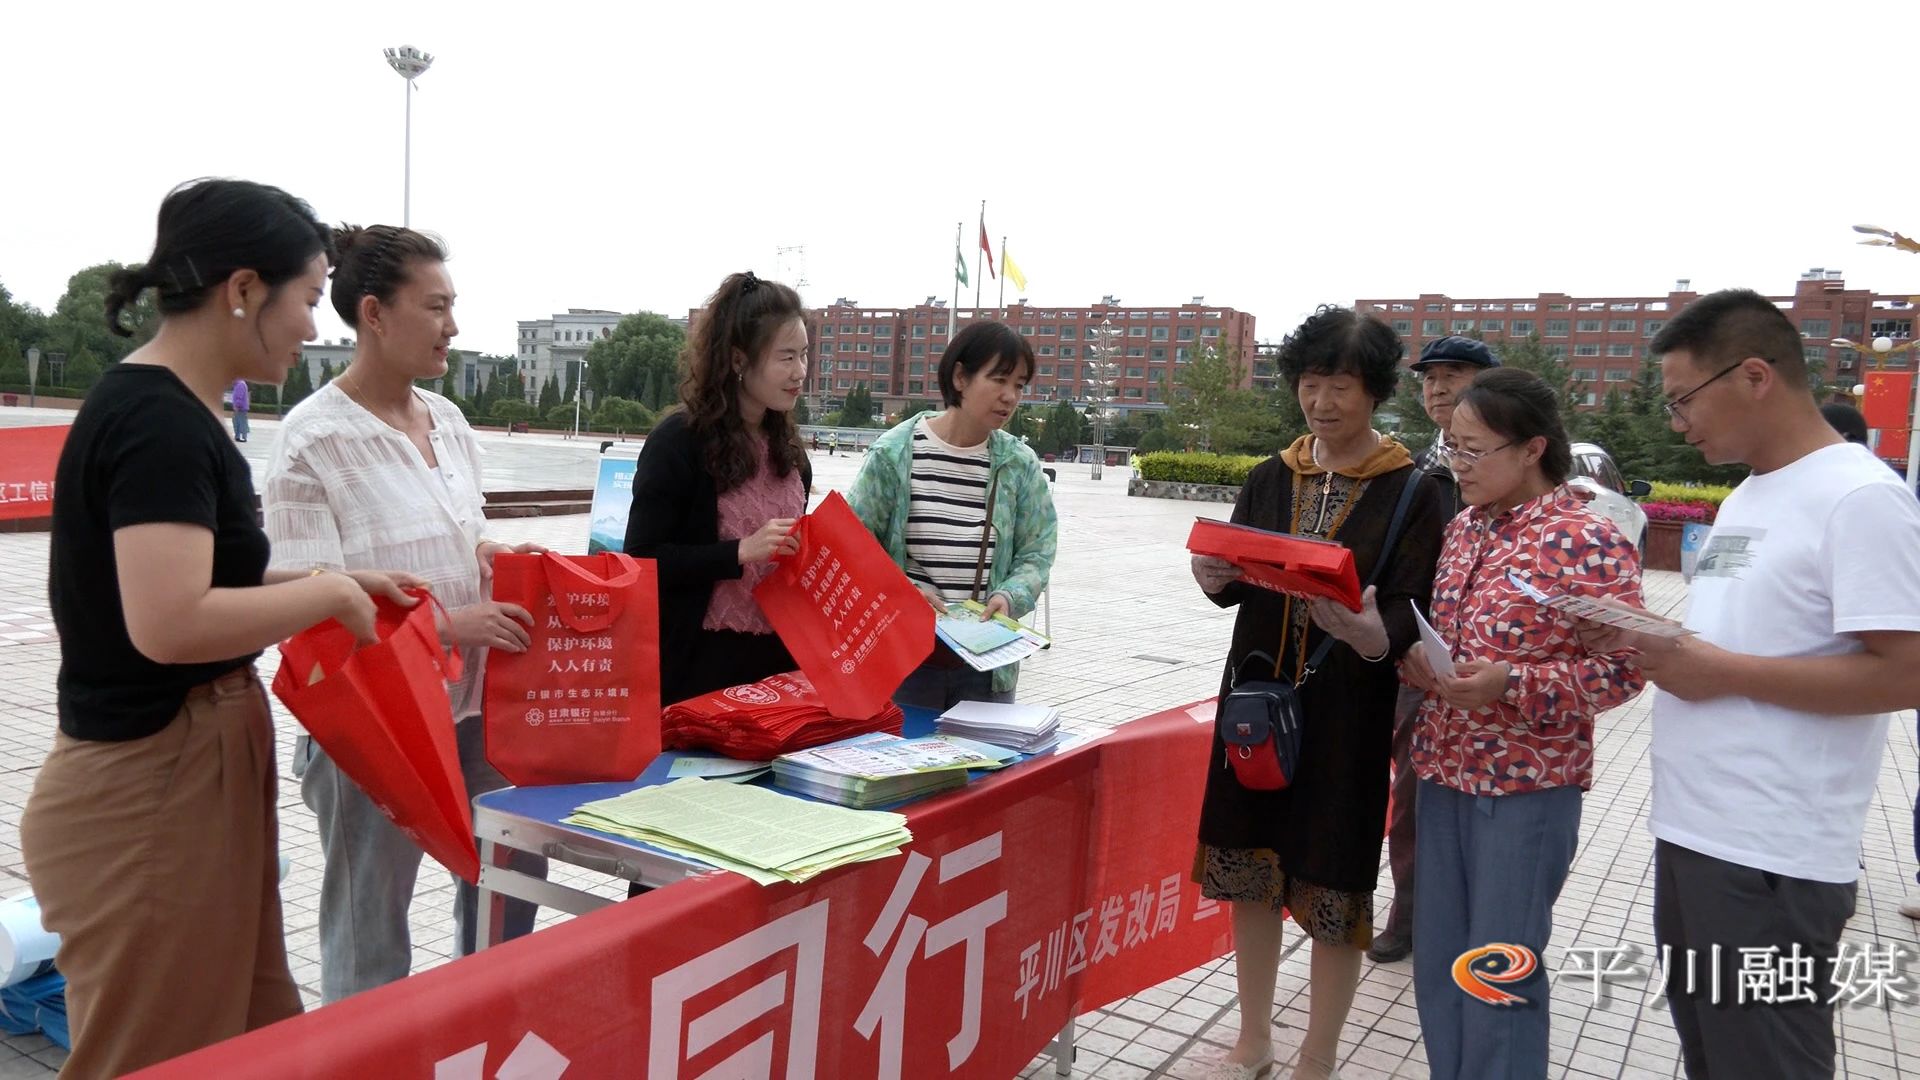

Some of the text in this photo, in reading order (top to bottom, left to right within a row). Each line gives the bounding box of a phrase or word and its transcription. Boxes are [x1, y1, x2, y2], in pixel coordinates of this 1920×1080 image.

[0, 480, 56, 503] 工信
[822, 572, 851, 617] 保护环境
[833, 586, 863, 631] 人人有责
[547, 636, 613, 652] 保护环境
[548, 658, 613, 673] 人人有责
[526, 688, 629, 700] 白银市生态环境局
[548, 708, 591, 718] 甘肃银行
[434, 830, 1008, 1080] 同行
[1014, 872, 1181, 1020] 平川区发改局
